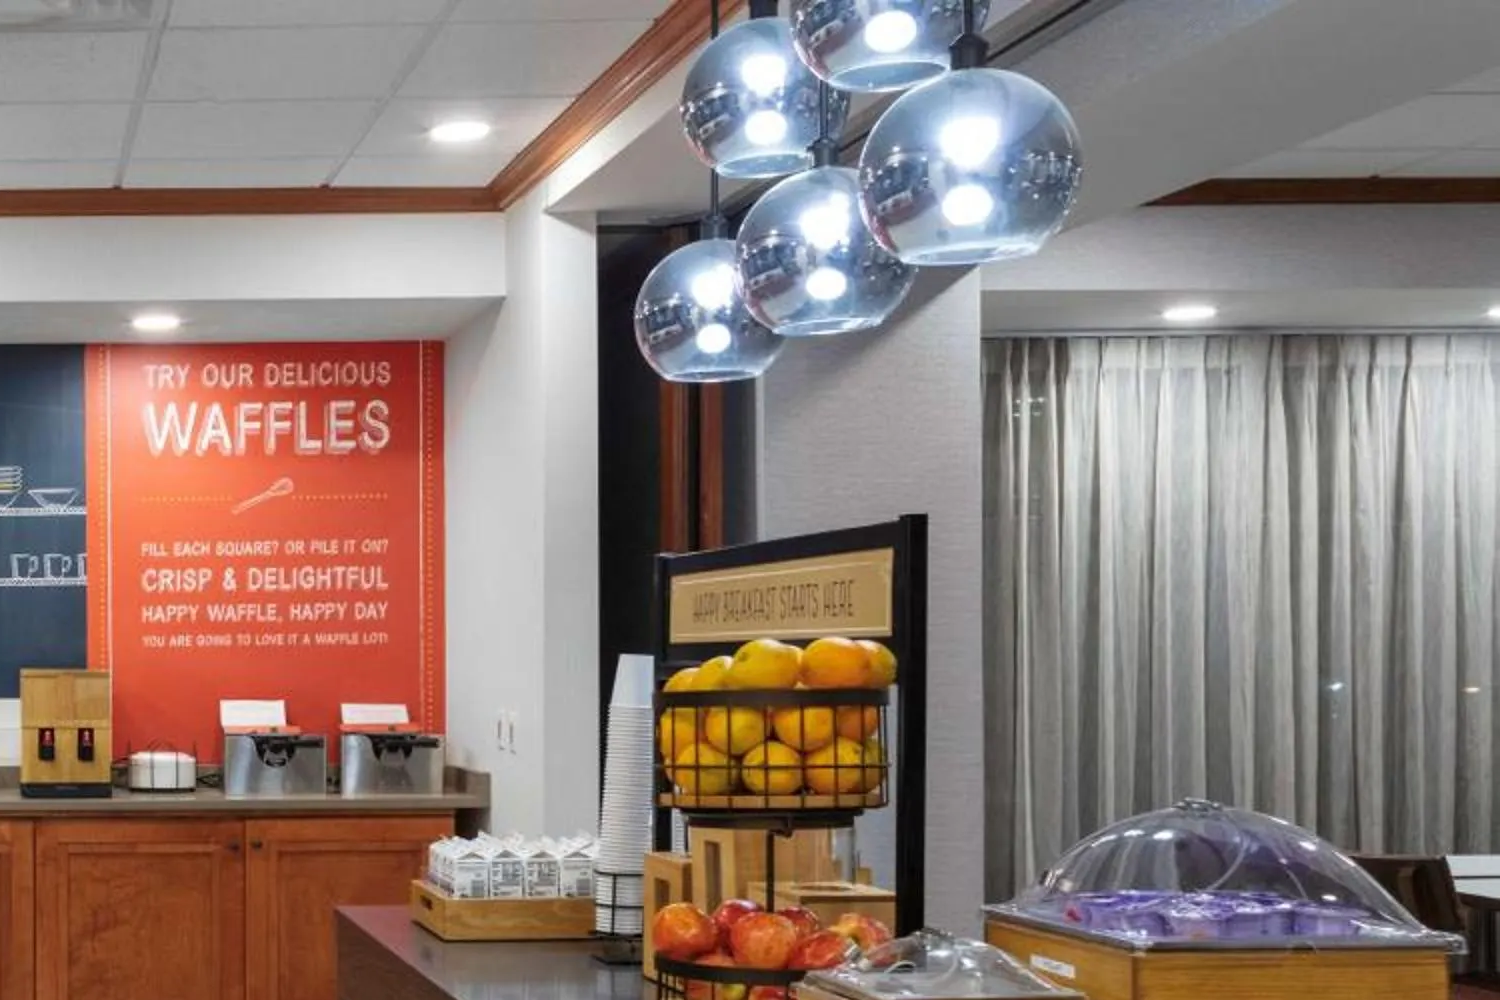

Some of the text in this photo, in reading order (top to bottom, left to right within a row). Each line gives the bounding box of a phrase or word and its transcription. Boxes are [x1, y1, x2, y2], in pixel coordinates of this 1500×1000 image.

[144, 361, 392, 389] TRY OUR DELICIOUS
[142, 398, 391, 457] WAFFLES
[141, 538, 389, 557] FILL EACH SQUARE? OR PILE IT ON?
[141, 565, 389, 593] CRISP & DELIGHTFUL
[141, 604, 200, 624] HAPPY
[290, 602, 348, 622] HAPPY
[354, 601, 389, 621] DAY
[780, 582, 819, 620] STARTS
[143, 635, 166, 649] YOU
[169, 634, 193, 648] ARE
[237, 633, 252, 647] TO
[255, 633, 285, 646] LOVE
[303, 632, 312, 645] A
